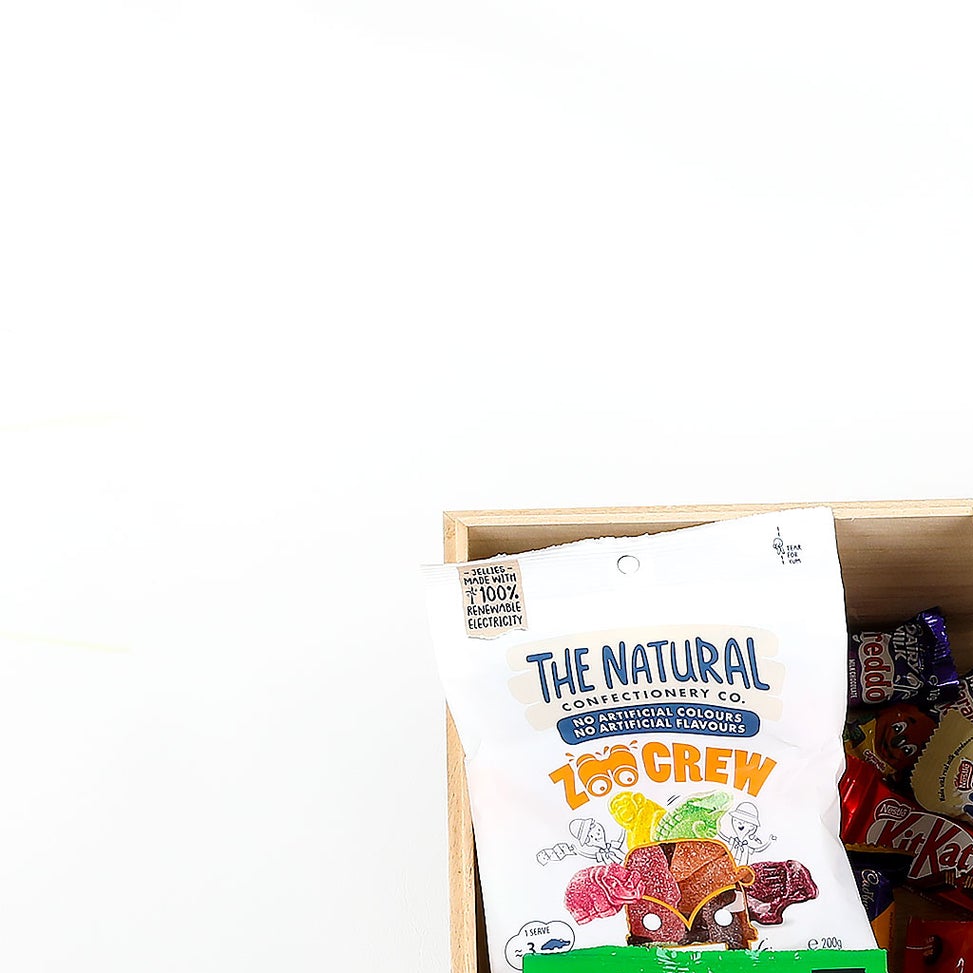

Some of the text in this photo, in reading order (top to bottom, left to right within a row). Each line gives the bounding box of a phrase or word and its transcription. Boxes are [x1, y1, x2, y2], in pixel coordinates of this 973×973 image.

[463, 573, 517, 586] MADE WITH
[472, 565, 506, 576] JELLIES
[480, 584, 519, 603] 100%
[466, 601, 521, 616] RENEWABLE
[468, 614, 523, 629] ELECTRICITY
[526, 636, 771, 704] THE NATURAL
[862, 632, 891, 701] reddo
[562, 688, 746, 712] CONFECTIONERY CO.
[572, 707, 743, 729] NO ARTIFICIAL COLOURS
[573, 718, 746, 739] NO ARTIFICIAL FLAVOURS
[641, 741, 778, 798] CREW
[529, 926, 551, 936] SERVE
[820, 936, 843, 950] 200g
